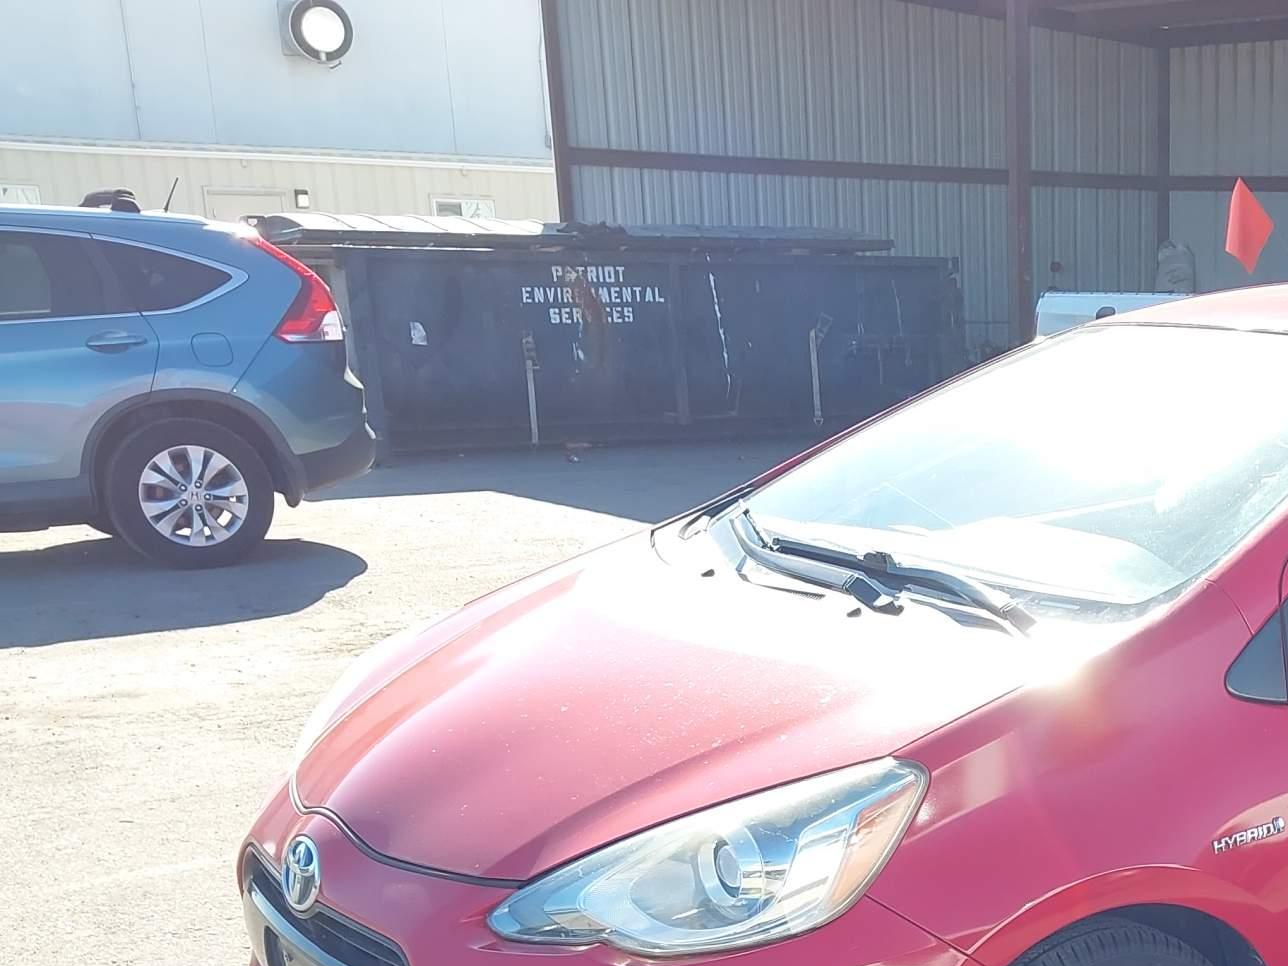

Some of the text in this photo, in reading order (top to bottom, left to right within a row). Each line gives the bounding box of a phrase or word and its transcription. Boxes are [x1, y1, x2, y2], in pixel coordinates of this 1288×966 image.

[551, 265, 625, 282] PATRIOT
[548, 307, 633, 324] SERVCES
[1213, 822, 1275, 855] HYBRID
